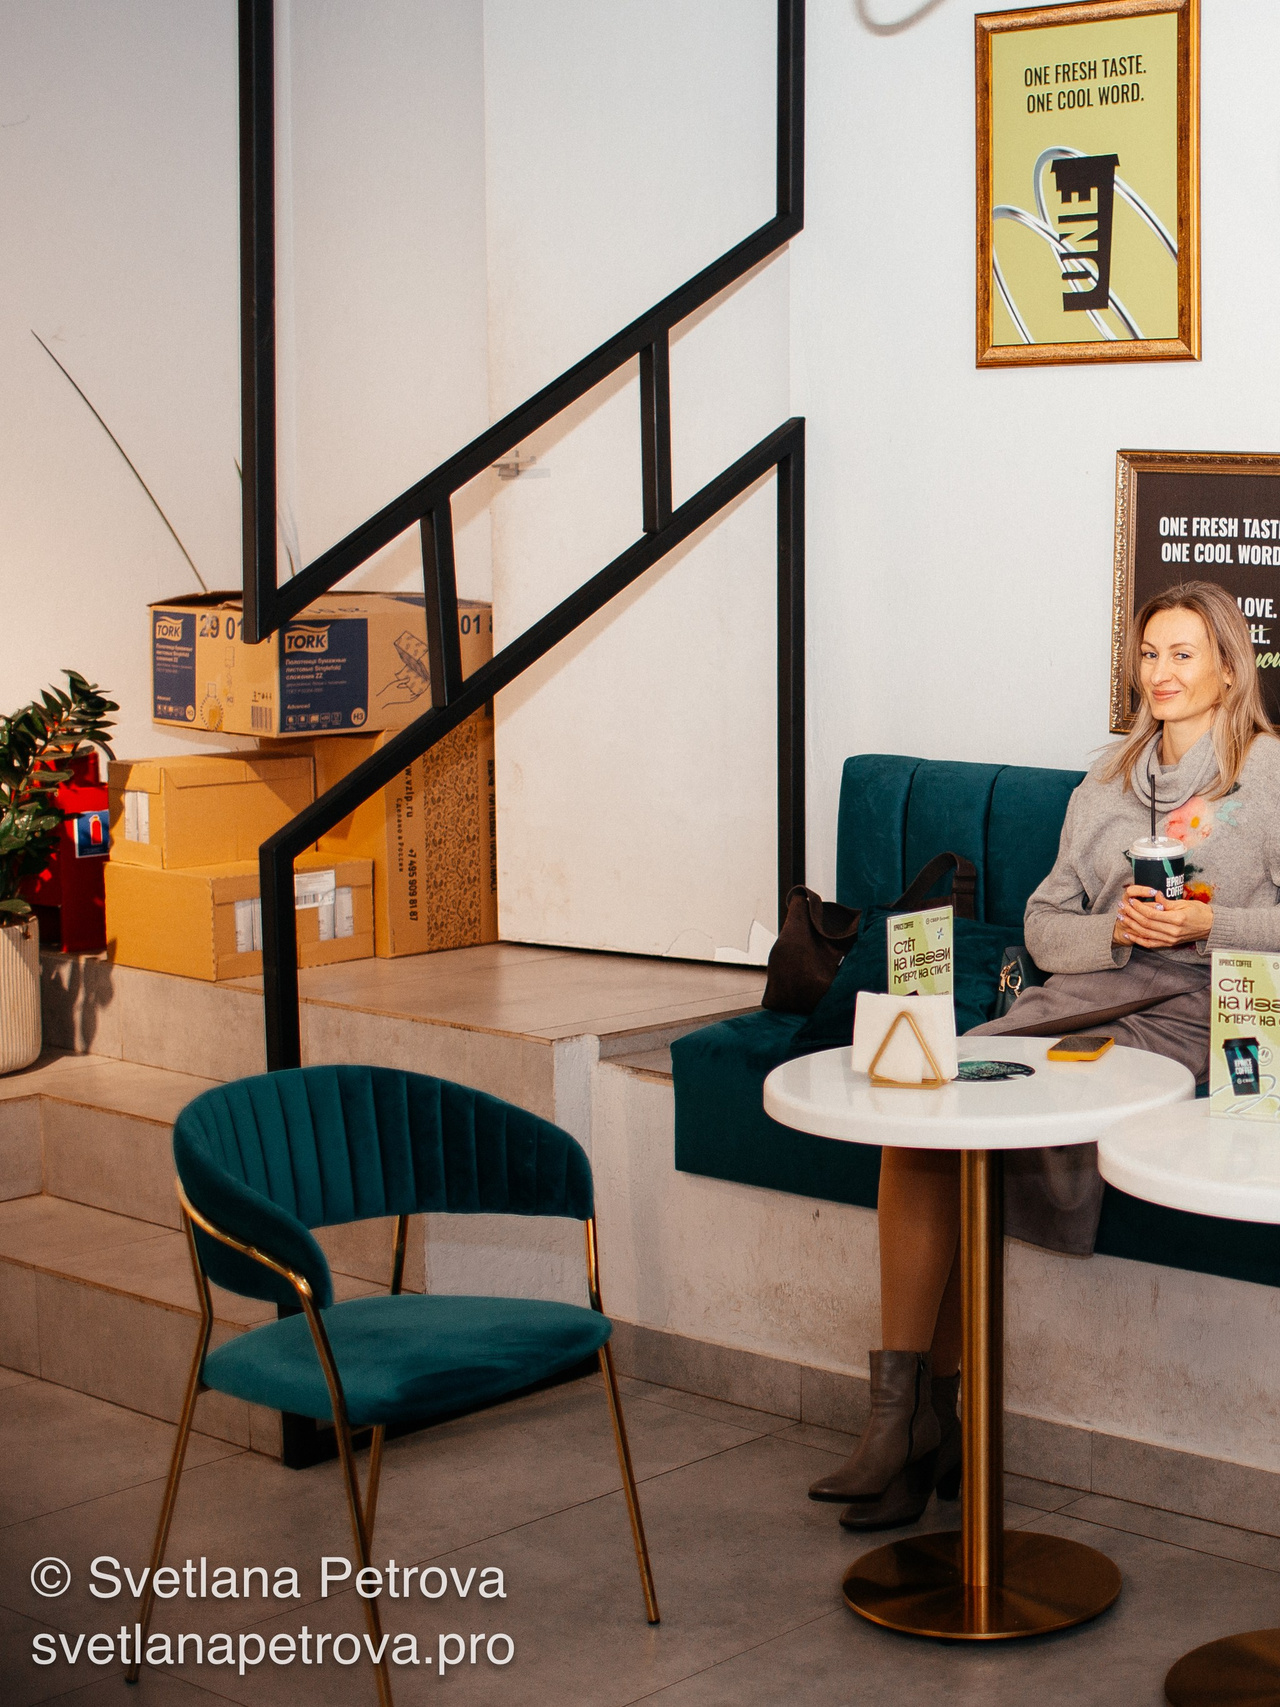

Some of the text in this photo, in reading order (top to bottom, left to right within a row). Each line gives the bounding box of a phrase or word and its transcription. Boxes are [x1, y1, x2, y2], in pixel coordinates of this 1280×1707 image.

[1024, 54, 1147, 87] ONE FRESH TASTE.
[1027, 82, 1144, 113] ONE COOL WORD.
[1159, 516, 1188, 537] ONE
[1192, 517, 1239, 538] FRESH
[1161, 543, 1190, 563] ONE
[1194, 543, 1233, 564] COOL
[157, 624, 181, 637] TORK
[200, 614, 219, 638] 29
[460, 614, 480, 635] 01
[287, 634, 326, 649] TORK
